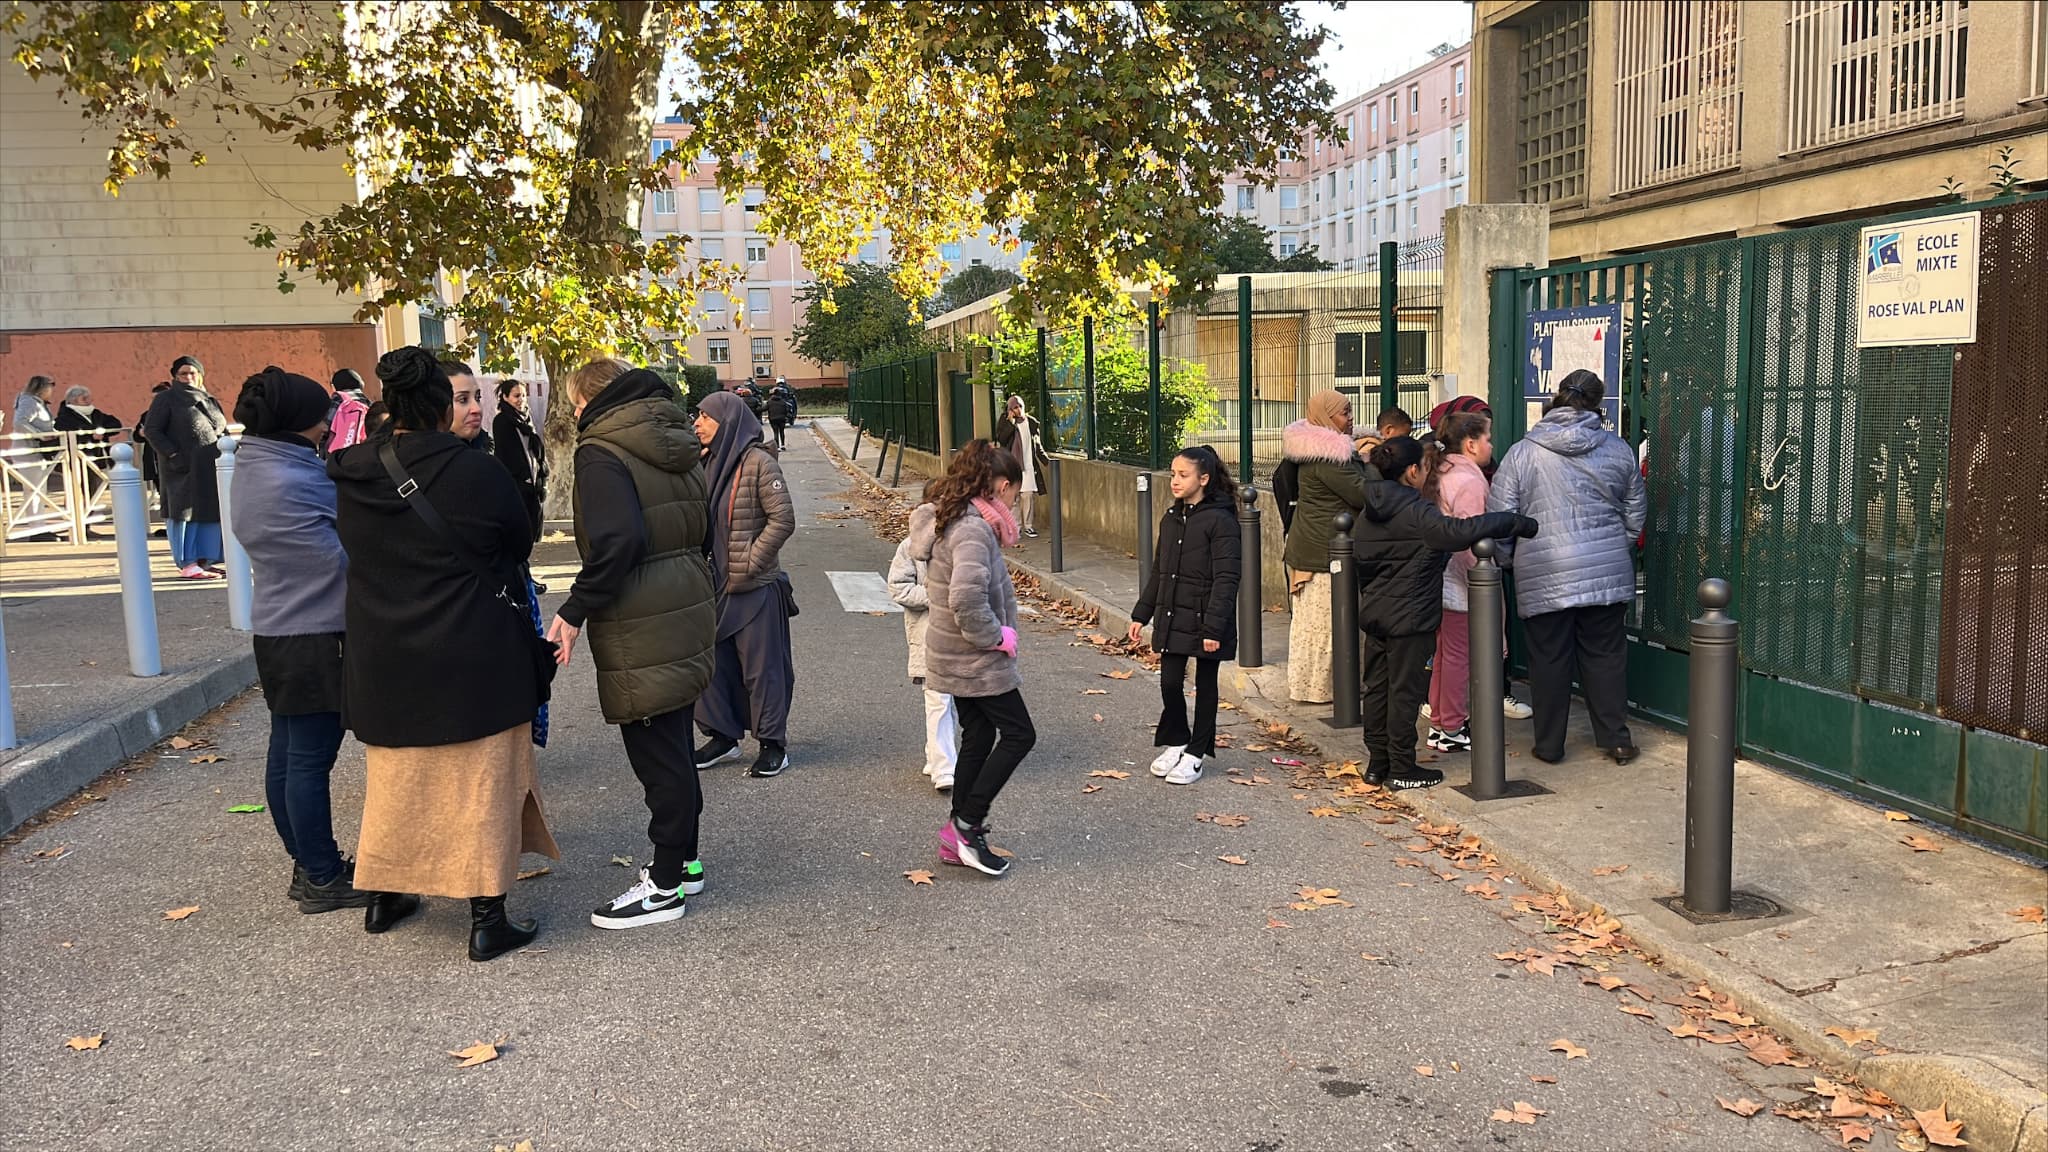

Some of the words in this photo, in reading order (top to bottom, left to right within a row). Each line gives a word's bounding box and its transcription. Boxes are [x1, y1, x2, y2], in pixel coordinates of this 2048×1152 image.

[1917, 233, 1959, 252] ÉCOLE
[1916, 255, 1958, 272] MIXTE
[1868, 303, 1900, 318] ROSE
[1902, 301, 1926, 316] VAL
[1929, 298, 1964, 314] PLAN
